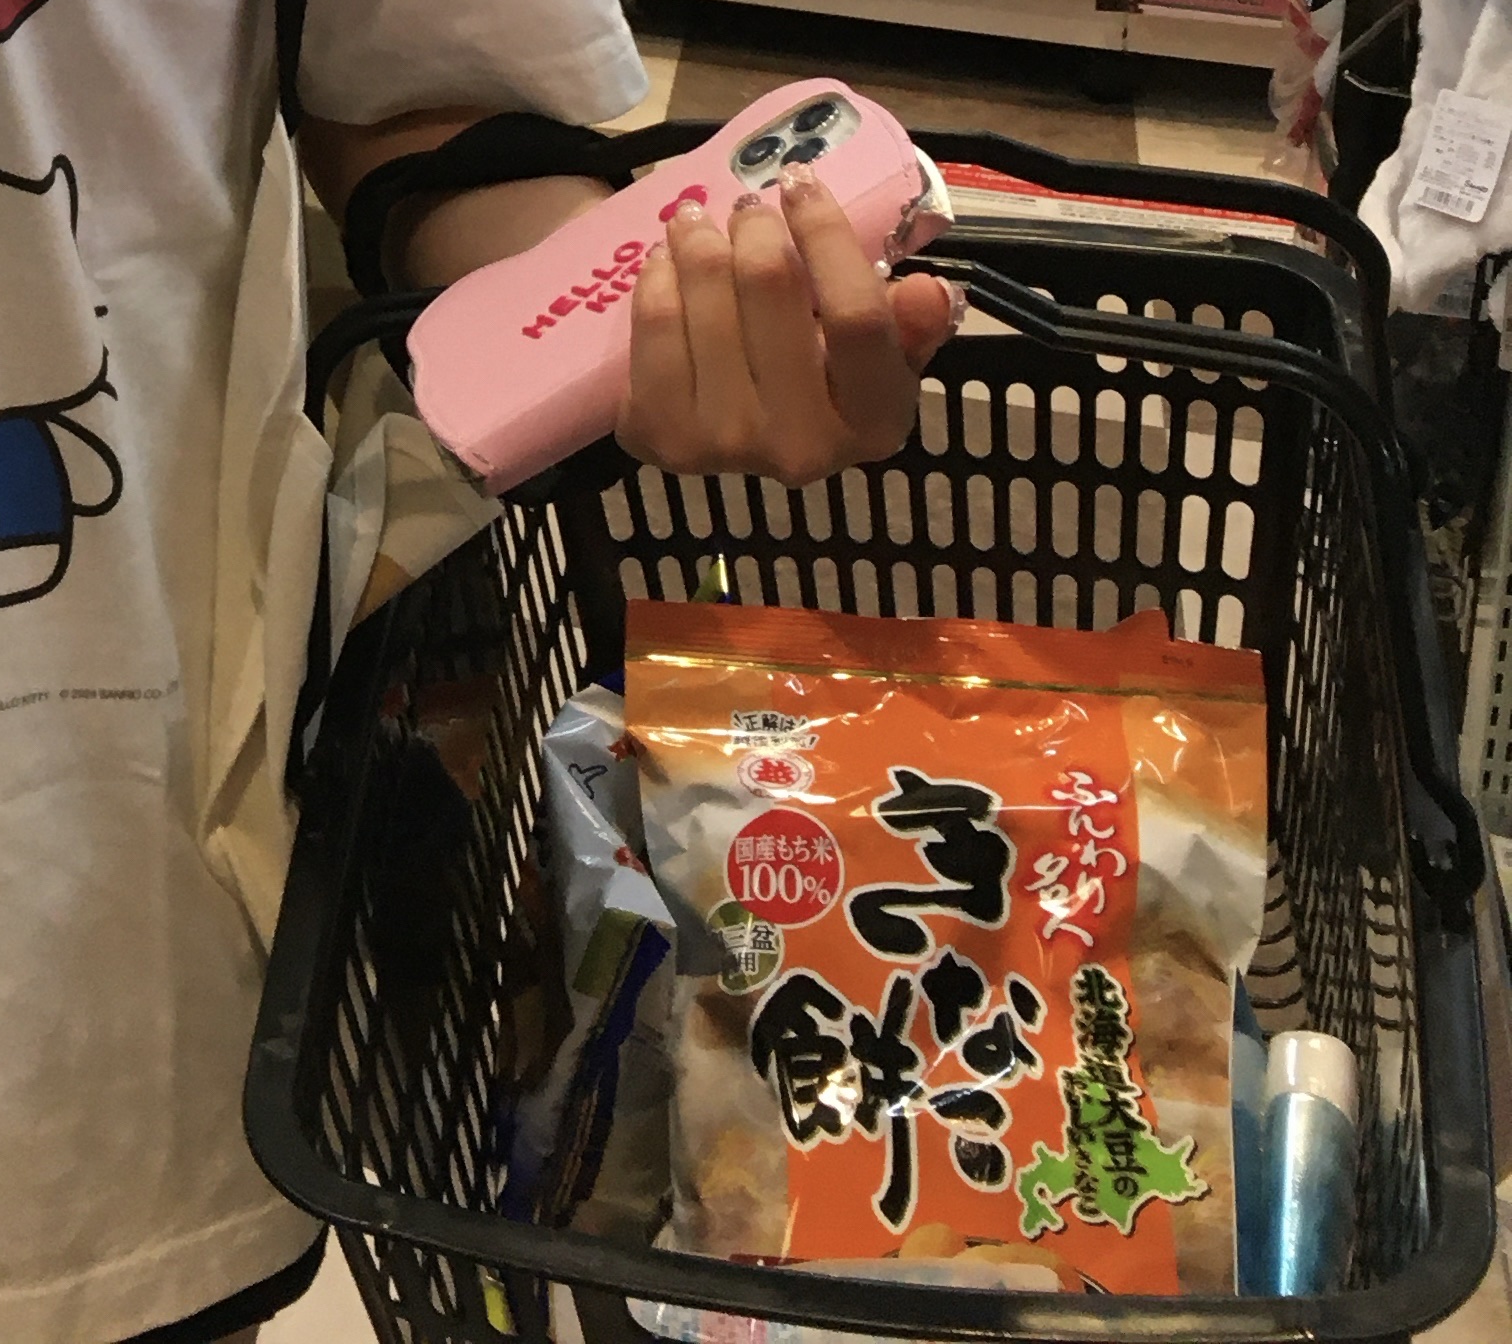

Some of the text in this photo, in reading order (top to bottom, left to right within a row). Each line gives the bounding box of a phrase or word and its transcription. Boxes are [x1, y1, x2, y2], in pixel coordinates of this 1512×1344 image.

[521, 239, 646, 340] HELLO
[734, 834, 835, 866] 国産もち米
[737, 862, 832, 907] 100%
[1051, 771, 1129, 915] ふんわり
[1074, 968, 1150, 1200] 北海道大豆の
